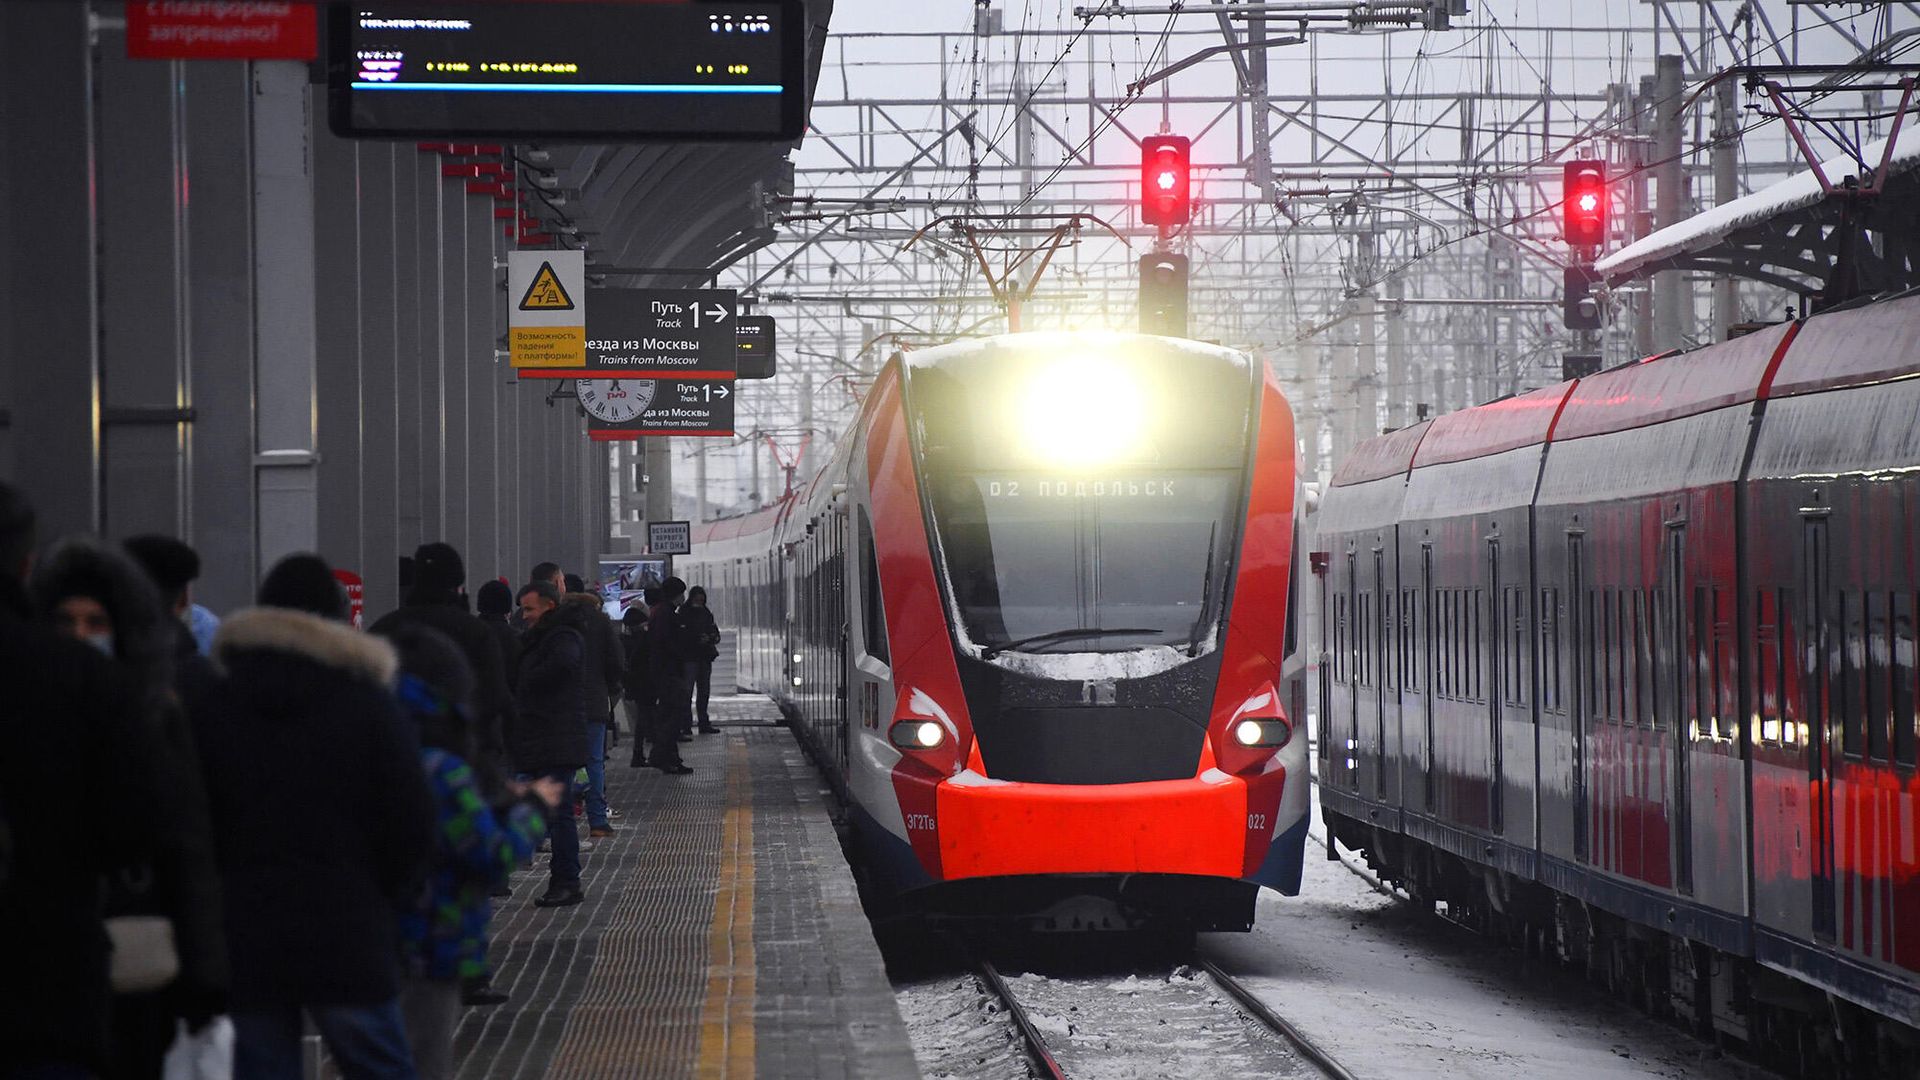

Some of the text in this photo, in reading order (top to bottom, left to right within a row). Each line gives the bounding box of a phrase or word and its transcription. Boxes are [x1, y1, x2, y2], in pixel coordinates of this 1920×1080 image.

[148, 22, 280, 45] запрещено!
[651, 301, 699, 329] Путь 1
[656, 318, 682, 328] Track
[517, 332, 577, 340] Возможность
[623, 340, 639, 350] из
[643, 338, 699, 350] Москвы
[599, 355, 699, 366] Trains from Moscow
[677, 383, 710, 403] Путь 1
[658, 409, 670, 417] из
[671, 408, 710, 417] Москвы
[663, 420, 680, 428] from
[990, 481, 1175, 498] D2 ПОДОЛЬСК
[655, 542, 684, 550] ВАГОНА
[1248, 814, 1266, 829] 022
